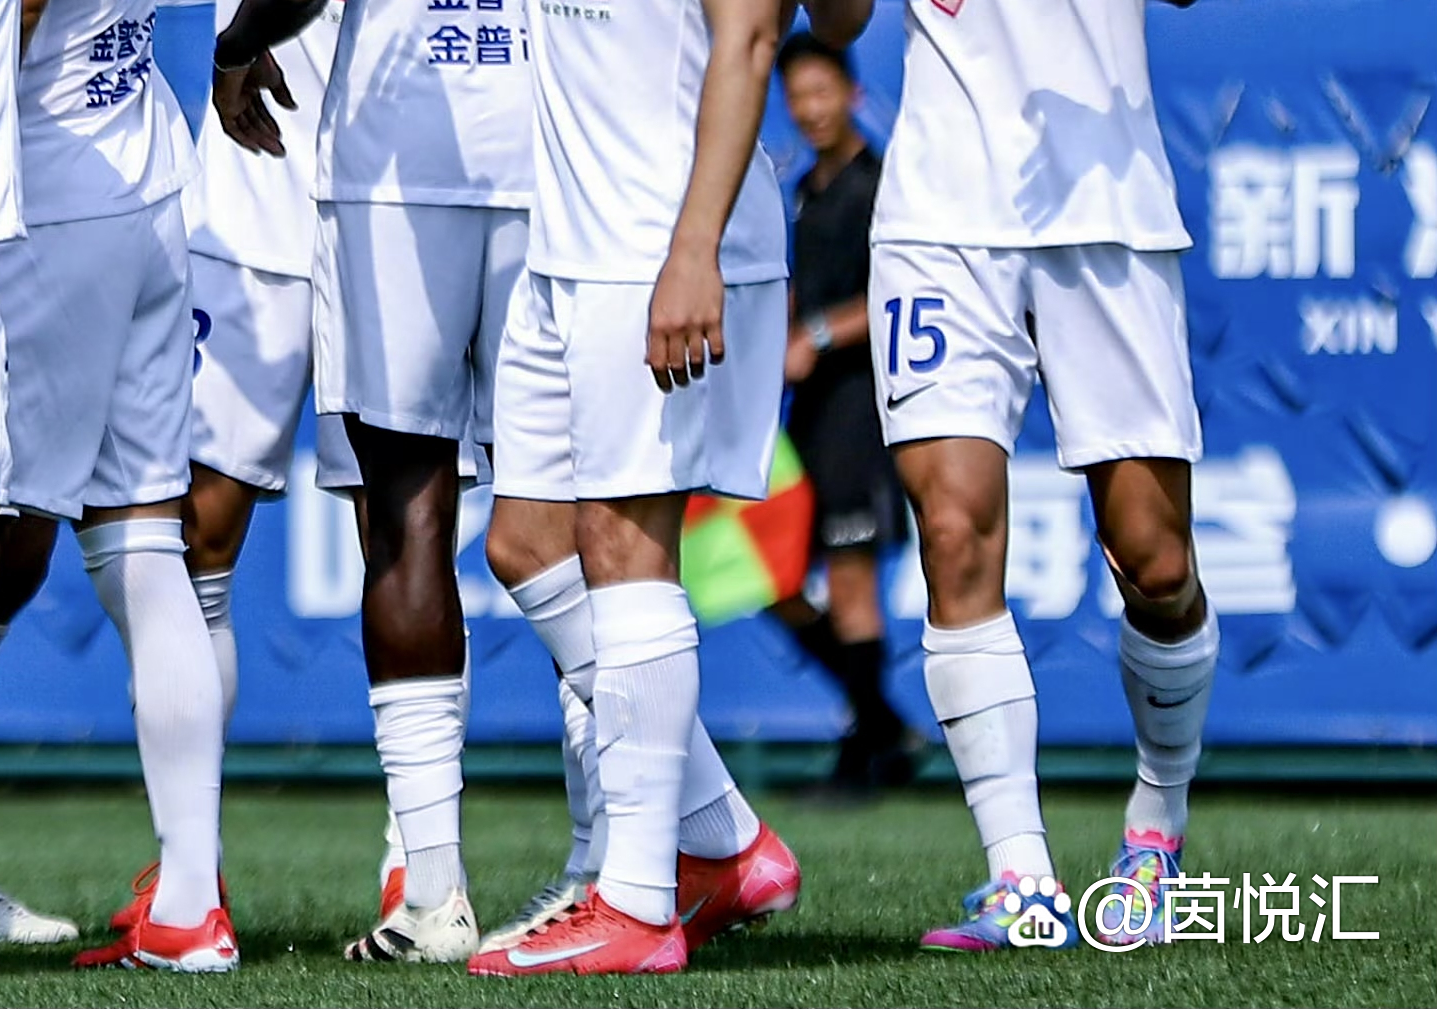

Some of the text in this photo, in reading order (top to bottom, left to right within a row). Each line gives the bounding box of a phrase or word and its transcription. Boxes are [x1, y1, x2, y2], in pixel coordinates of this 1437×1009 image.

[427, 25, 529, 66] 金普
[1207, 143, 1437, 280] 新
[885, 297, 948, 377] 15
[1300, 296, 1398, 355] XIN
